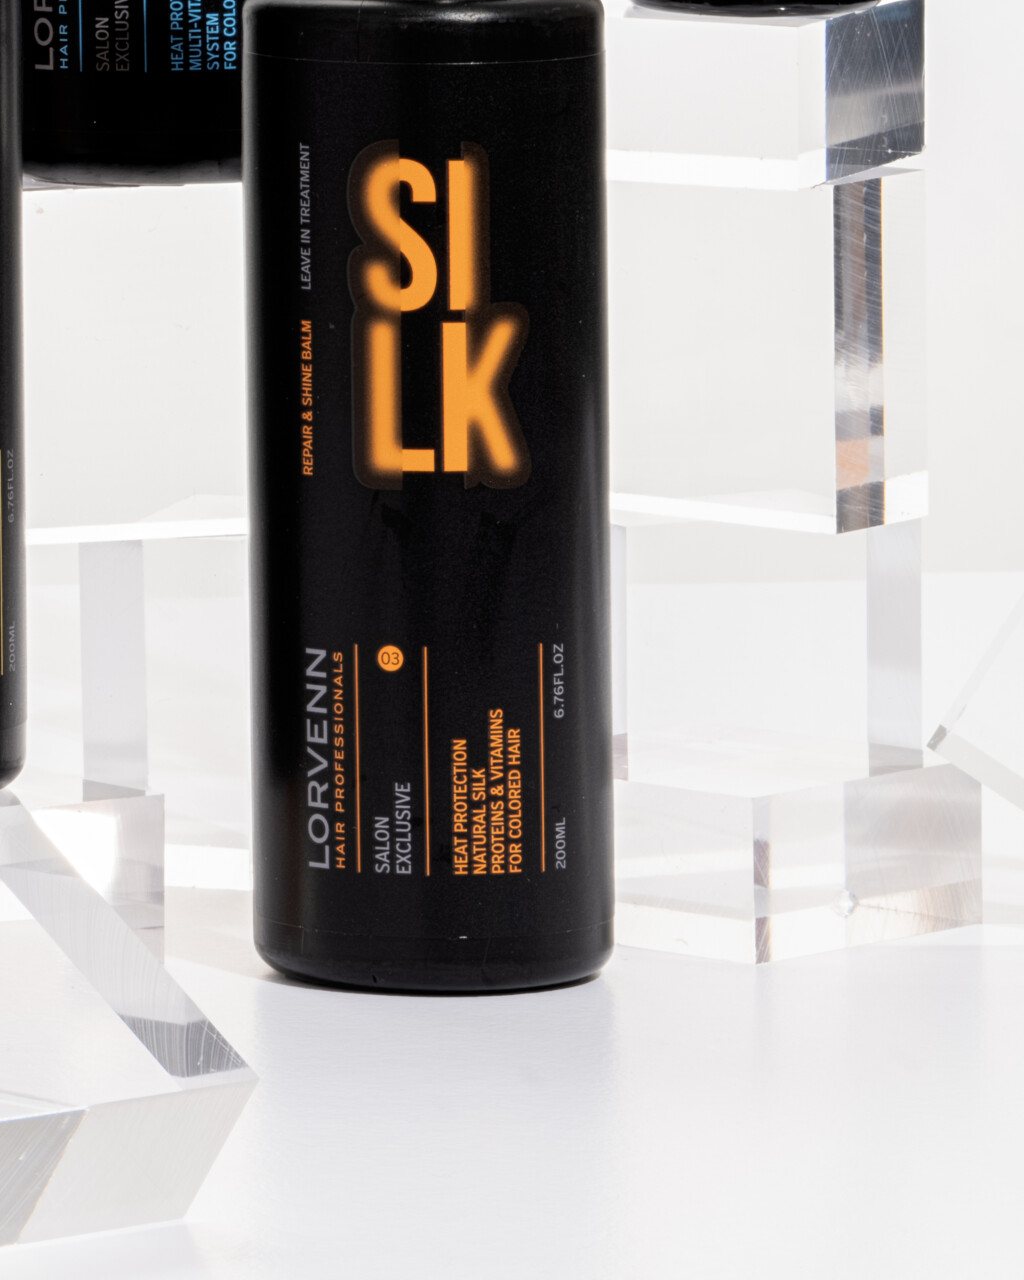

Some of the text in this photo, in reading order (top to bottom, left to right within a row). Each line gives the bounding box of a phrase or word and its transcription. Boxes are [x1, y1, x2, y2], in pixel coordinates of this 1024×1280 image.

[59, 24, 68, 69] HAIR
[95, 17, 109, 71] SALON
[171, 35, 183, 71] HEAT
[206, 13, 219, 70] SYSTEM
[224, 41, 236, 70] FOR
[300, 143, 311, 290] LEAVE IN TREATMENT
[361, 158, 476, 311] SI
[301, 320, 313, 475] REPAIR & SHINE BALM
[367, 317, 518, 475] LK
[381, 652, 400, 665] 03
[554, 643, 564, 718] 6.76FL.OZ
[306, 648, 329, 869] LORVENN
[334, 652, 345, 868] HAIR PROFESSIONALS
[453, 739, 468, 875] HEAT PROTECTION
[490, 709, 504, 874] PROTEINS & VITAMINS
[508, 729, 522, 873] FOR COLORED HAIR
[375, 816, 389, 874] SALON
[396, 782, 411, 874] EXCLUSIVE
[473, 768, 486, 874] NATURAL SILK
[556, 817, 566, 869] 200ML
